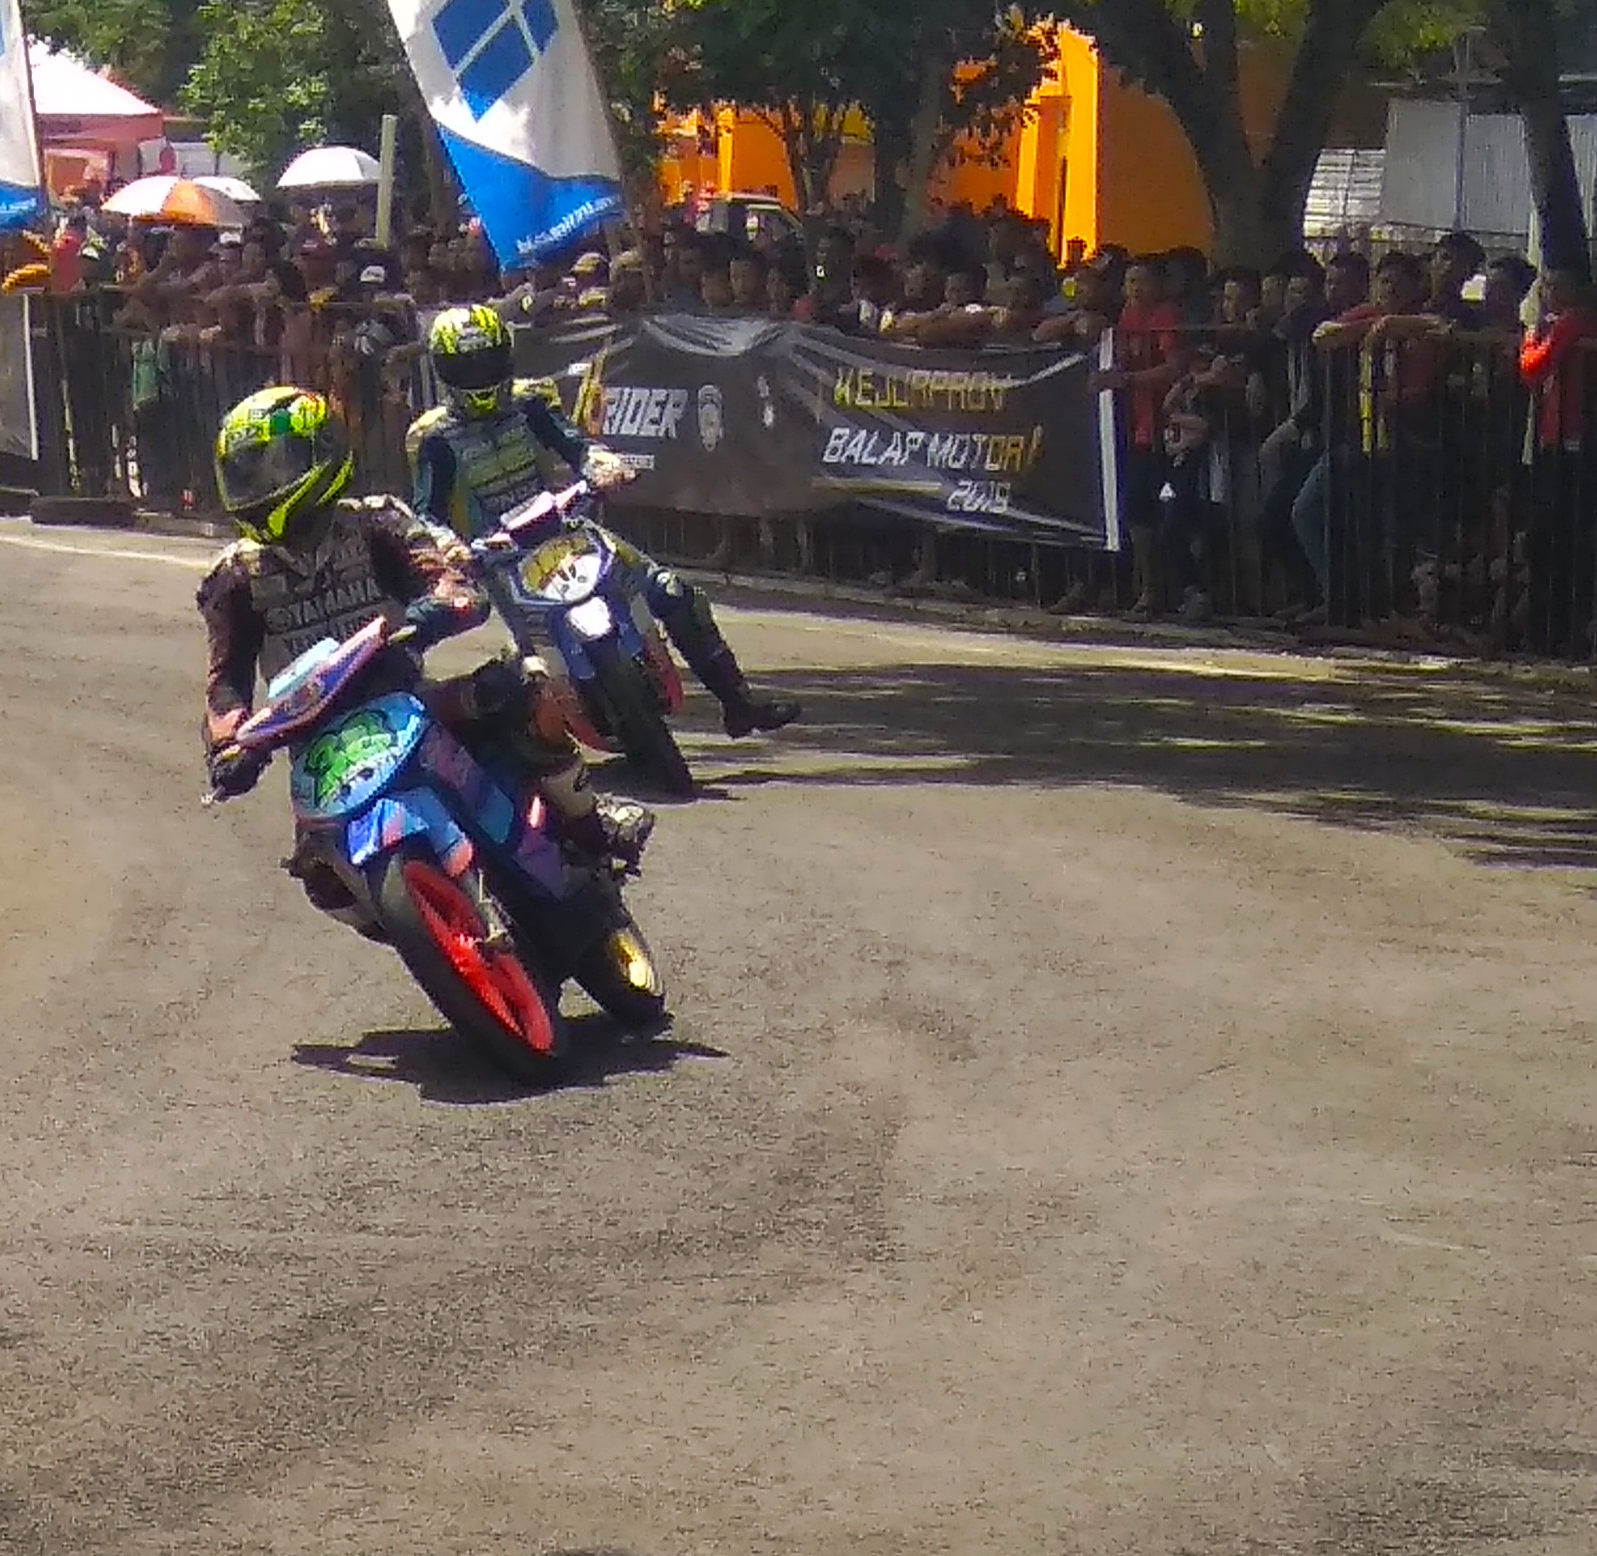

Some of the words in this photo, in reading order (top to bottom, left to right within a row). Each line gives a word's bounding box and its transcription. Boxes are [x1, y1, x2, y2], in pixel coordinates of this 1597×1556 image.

[601, 385, 689, 439] RIDER
[821, 426, 927, 467] BALAP
[927, 431, 1026, 472] MOTOR
[945, 479, 1013, 514] 2019
[287, 575, 383, 626] YAMAHA
